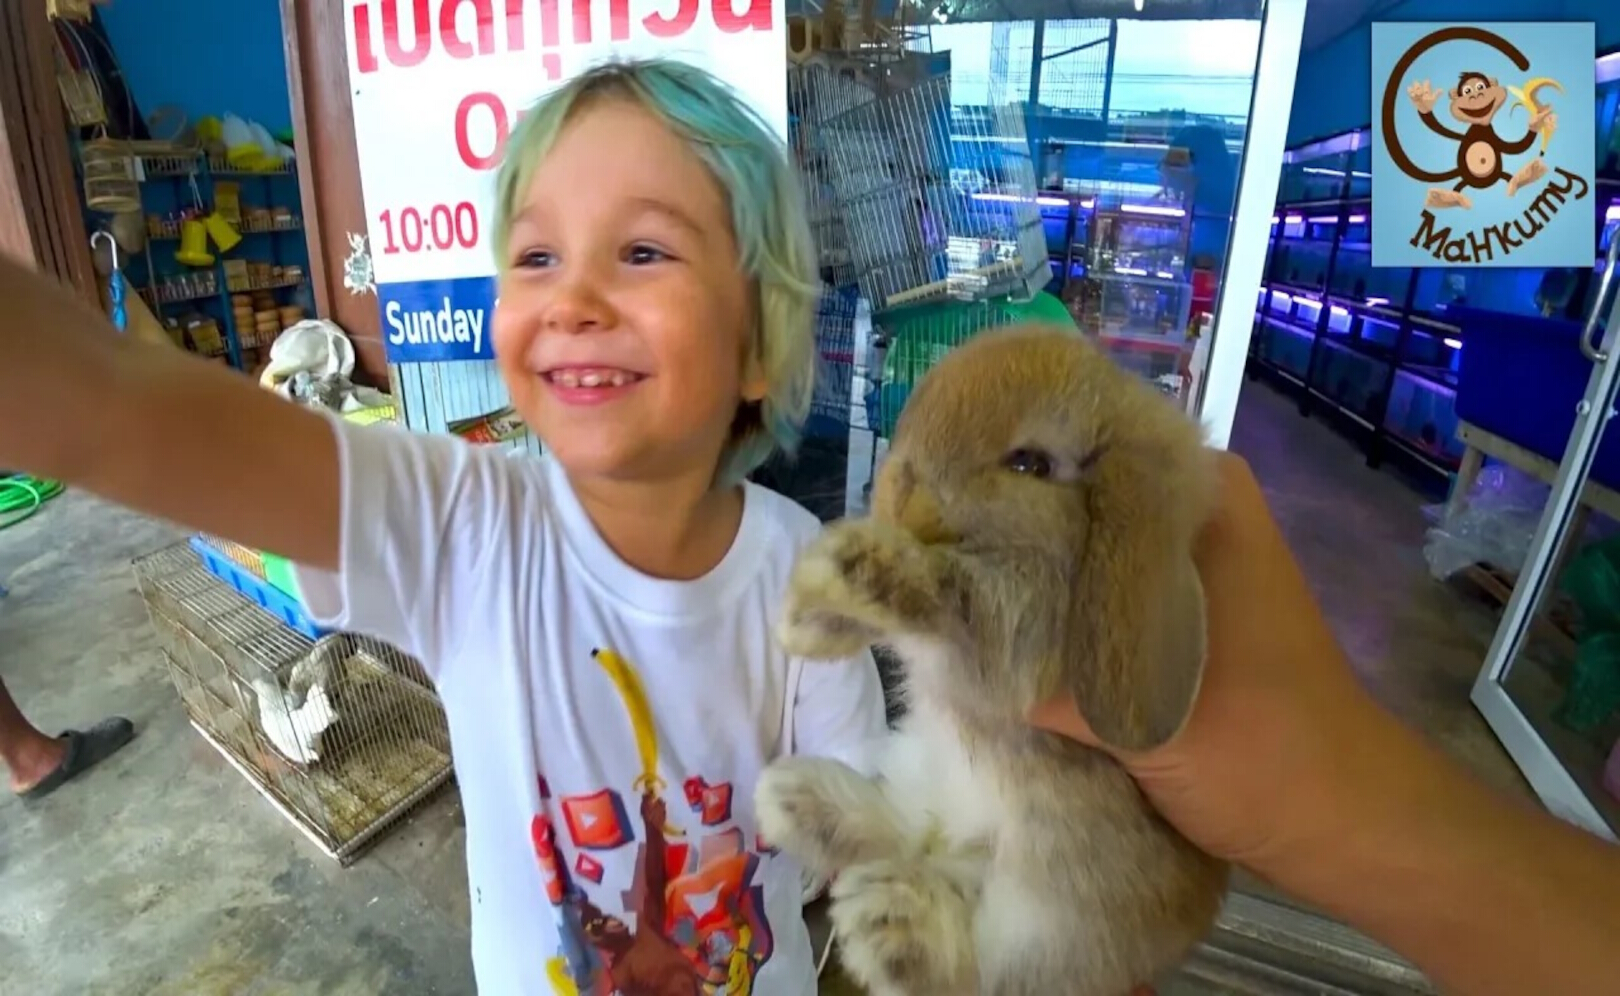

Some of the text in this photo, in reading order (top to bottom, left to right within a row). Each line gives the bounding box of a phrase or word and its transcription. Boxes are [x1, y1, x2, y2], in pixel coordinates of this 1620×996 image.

[455, 91, 531, 171] O
[379, 201, 479, 254] 10:00
[385, 296, 484, 354] Sunday
